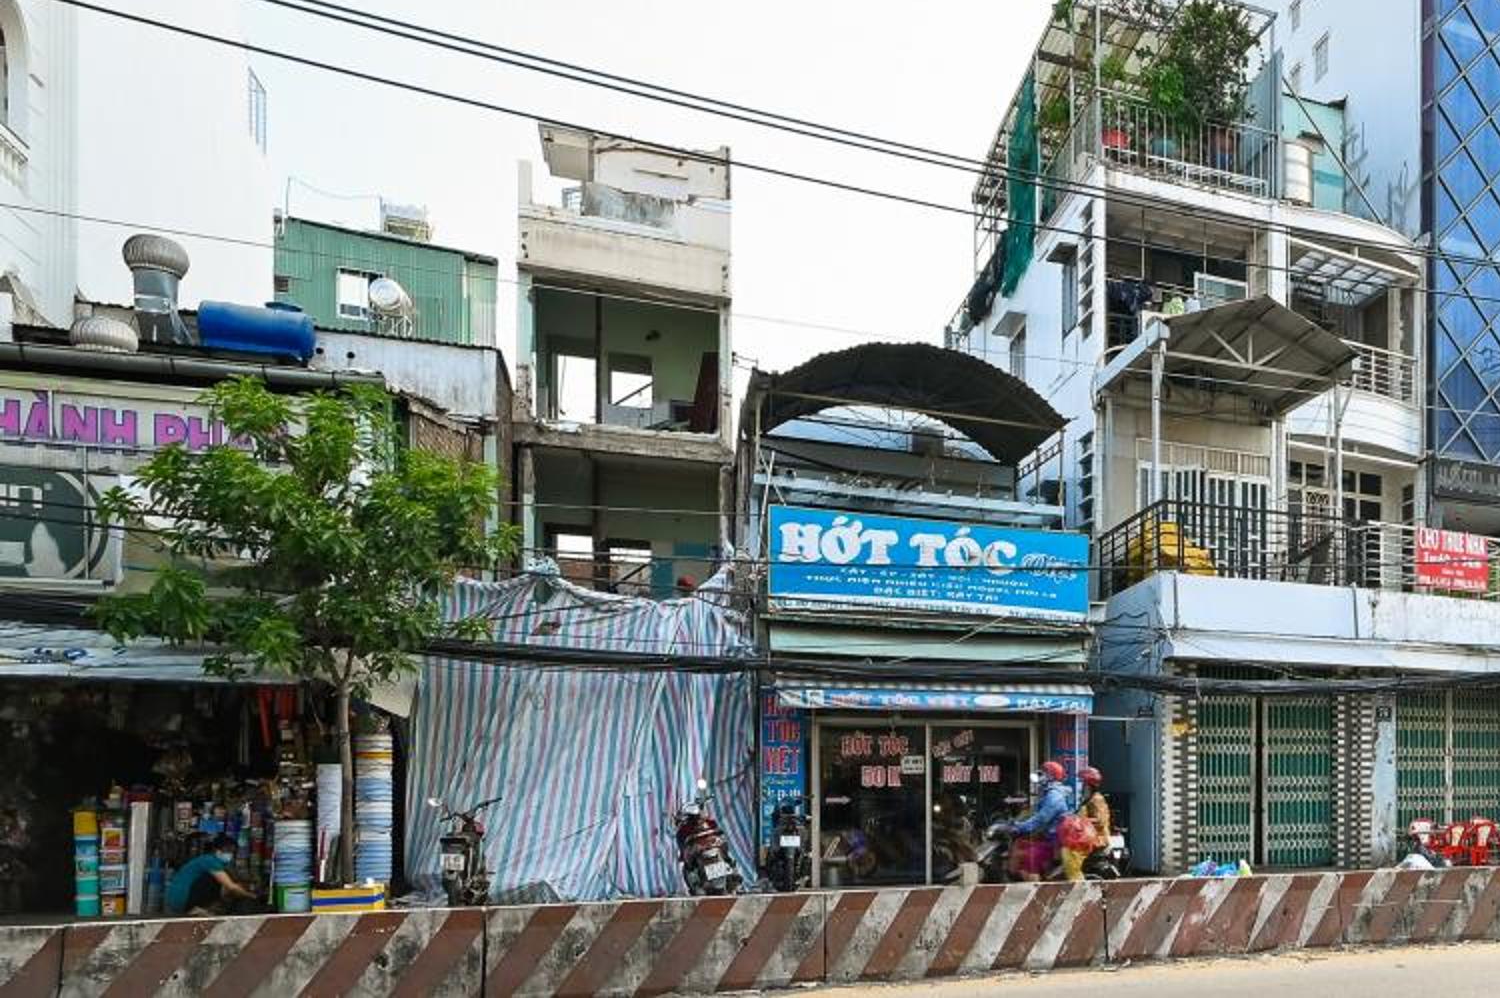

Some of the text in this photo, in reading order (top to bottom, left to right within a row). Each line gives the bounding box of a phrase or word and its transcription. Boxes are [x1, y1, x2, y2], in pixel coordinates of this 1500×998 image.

[779, 515, 899, 565] HỚT
[910, 527, 1017, 576] TÓC
[861, 765, 887, 789] 50
